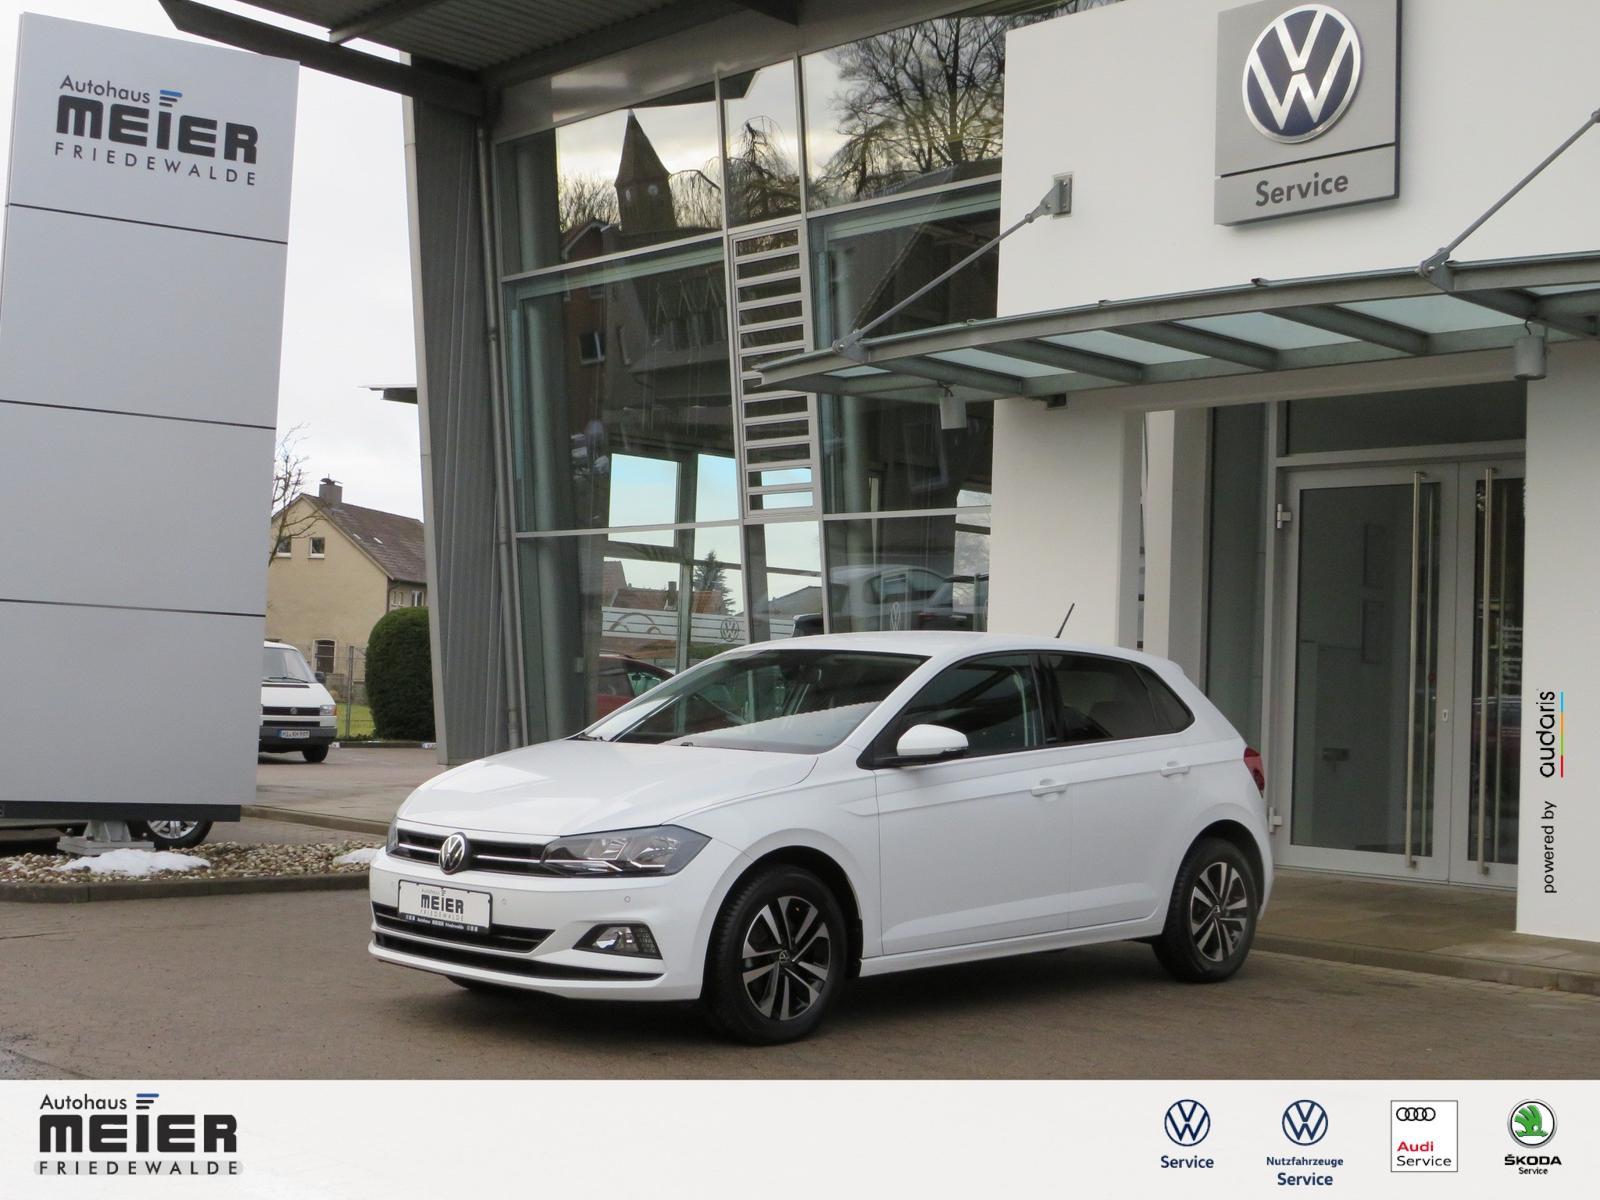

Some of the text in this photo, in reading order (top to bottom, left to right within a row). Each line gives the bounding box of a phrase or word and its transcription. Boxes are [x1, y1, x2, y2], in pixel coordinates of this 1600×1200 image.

[59, 74, 151, 105] Autohaus
[55, 94, 259, 165] MEIER
[54, 141, 257, 186] FRIEDEWALDE
[1255, 171, 1349, 207] Service
[420, 893, 464, 915] MEIER
